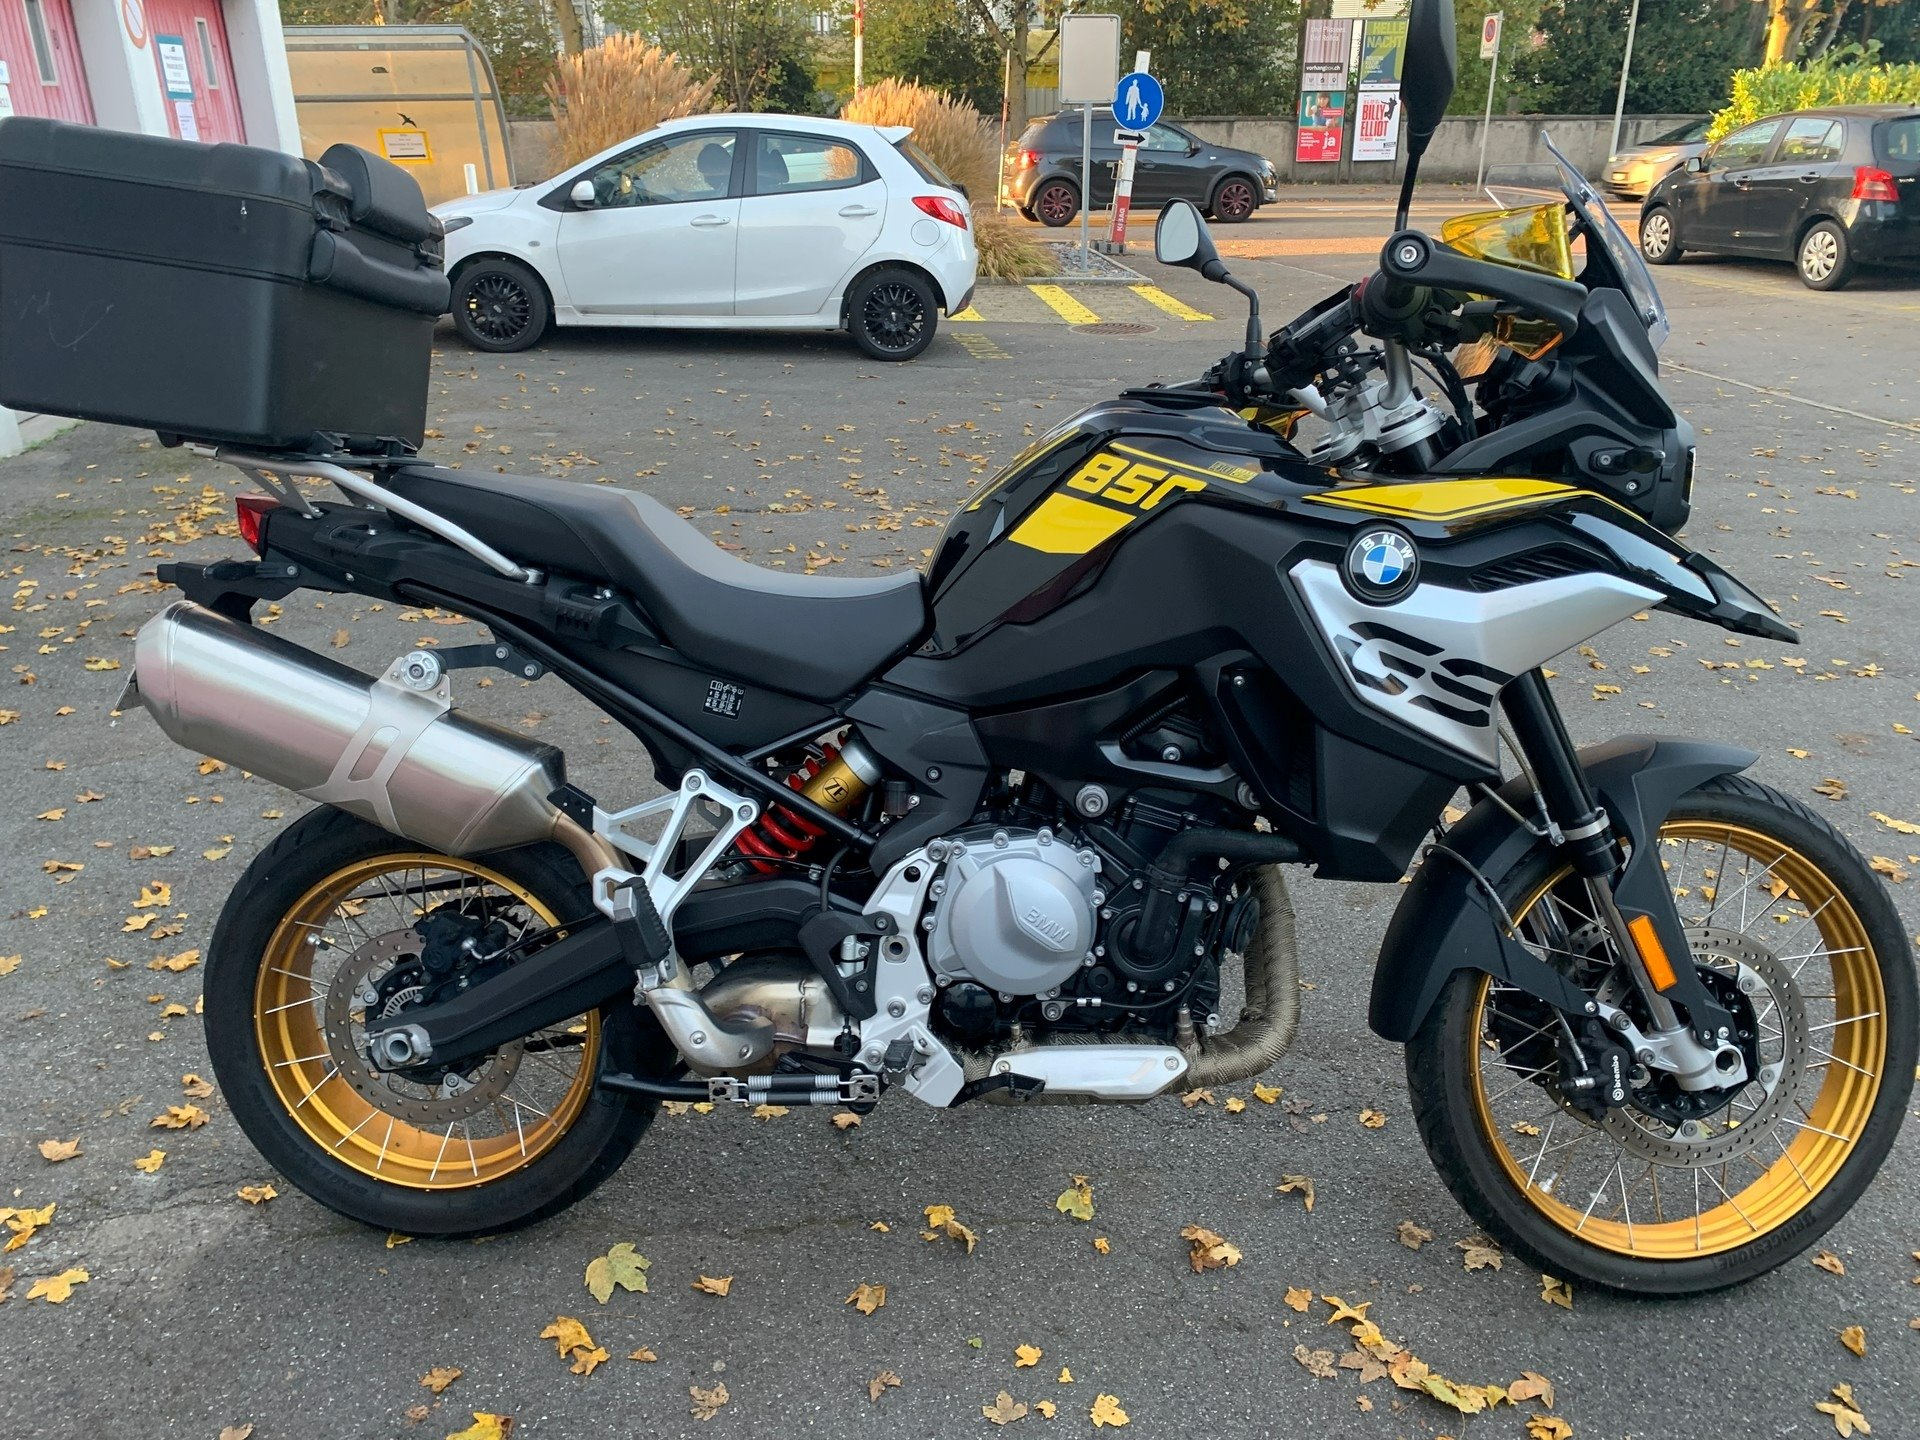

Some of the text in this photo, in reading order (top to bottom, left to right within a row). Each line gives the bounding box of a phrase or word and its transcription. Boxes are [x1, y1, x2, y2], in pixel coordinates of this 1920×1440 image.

[1373, 22, 1406, 35] HELLE
[1367, 35, 1404, 48] NACHT
[1361, 104, 1386, 121] BILLY
[1360, 121, 1389, 137] ELLIOT
[1117, 208, 1126, 232] KIBAG
[1361, 534, 1413, 559] BMW
[823, 777, 849, 803] ZF
[1024, 907, 1071, 943] BMW
[1611, 1055, 1622, 1089] brembo
